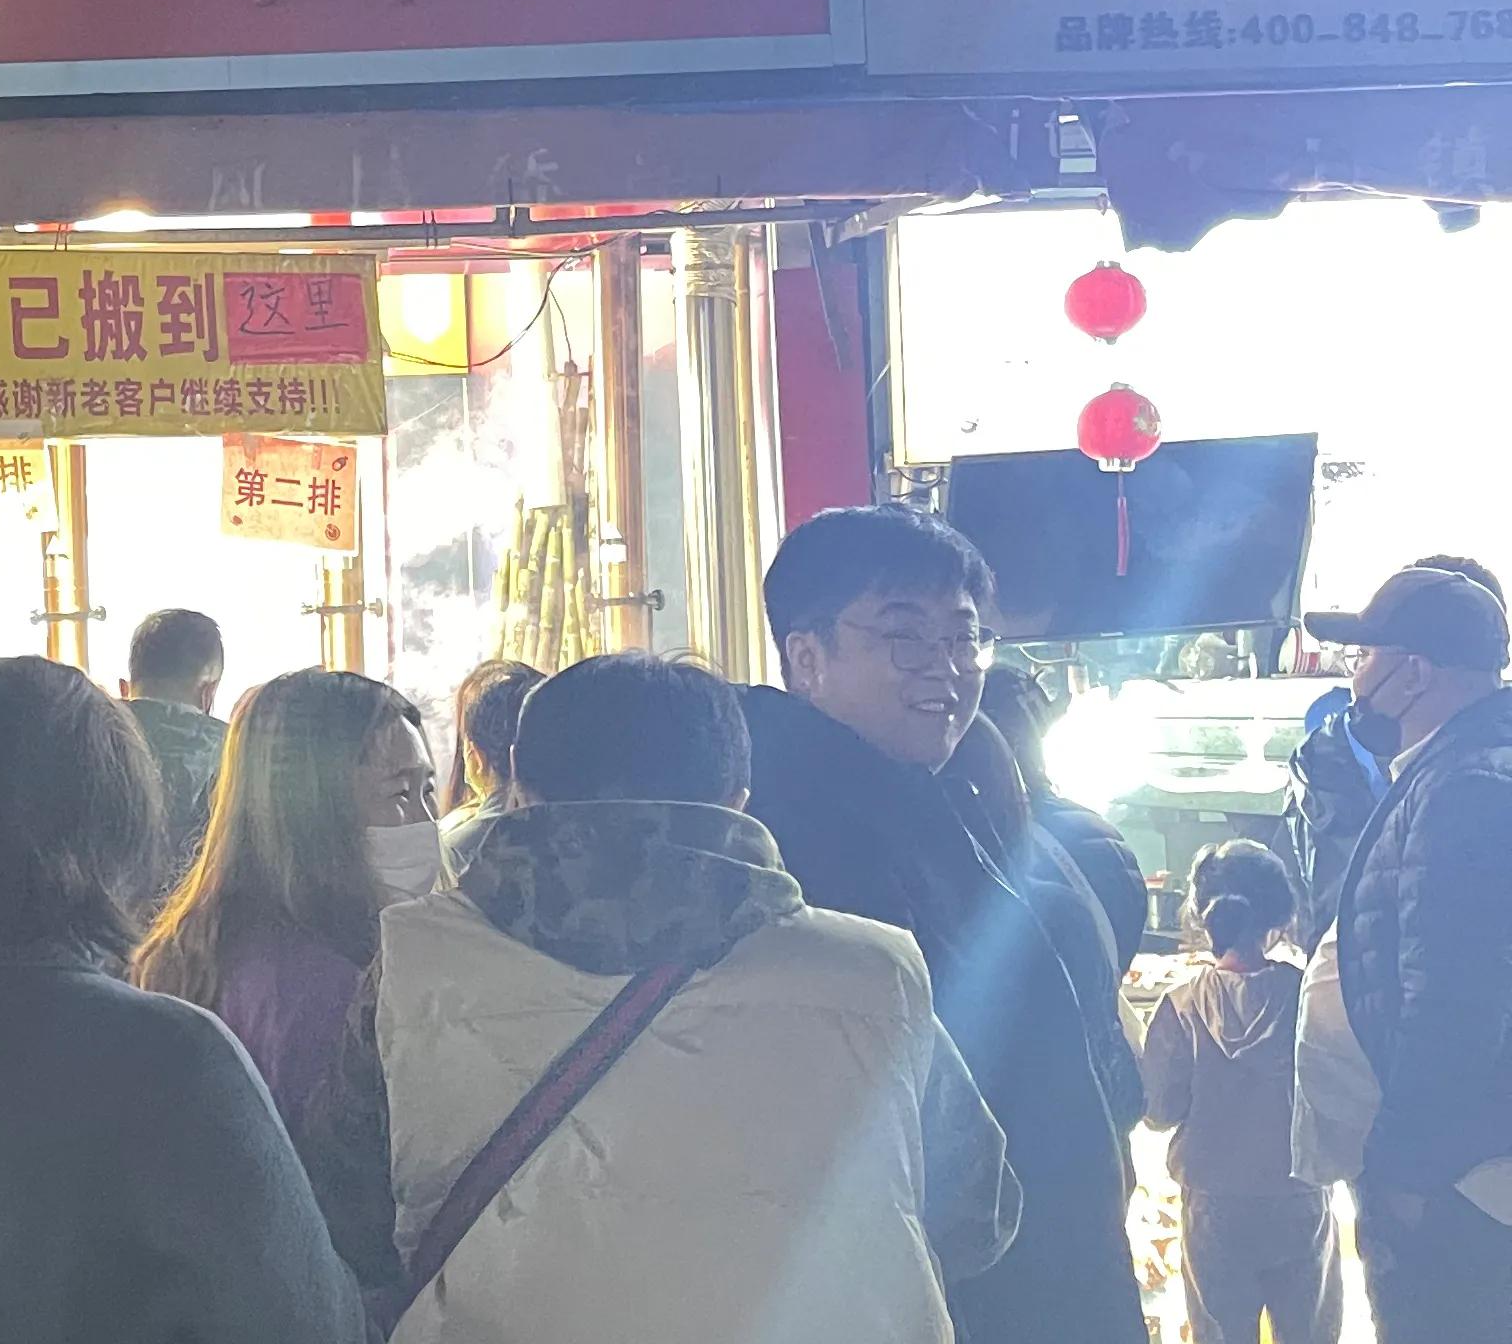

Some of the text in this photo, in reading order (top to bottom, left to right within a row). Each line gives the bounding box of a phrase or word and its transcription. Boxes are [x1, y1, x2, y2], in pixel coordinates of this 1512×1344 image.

[238, 277, 349, 336] 这里
[234, 467, 342, 517] 第二排
